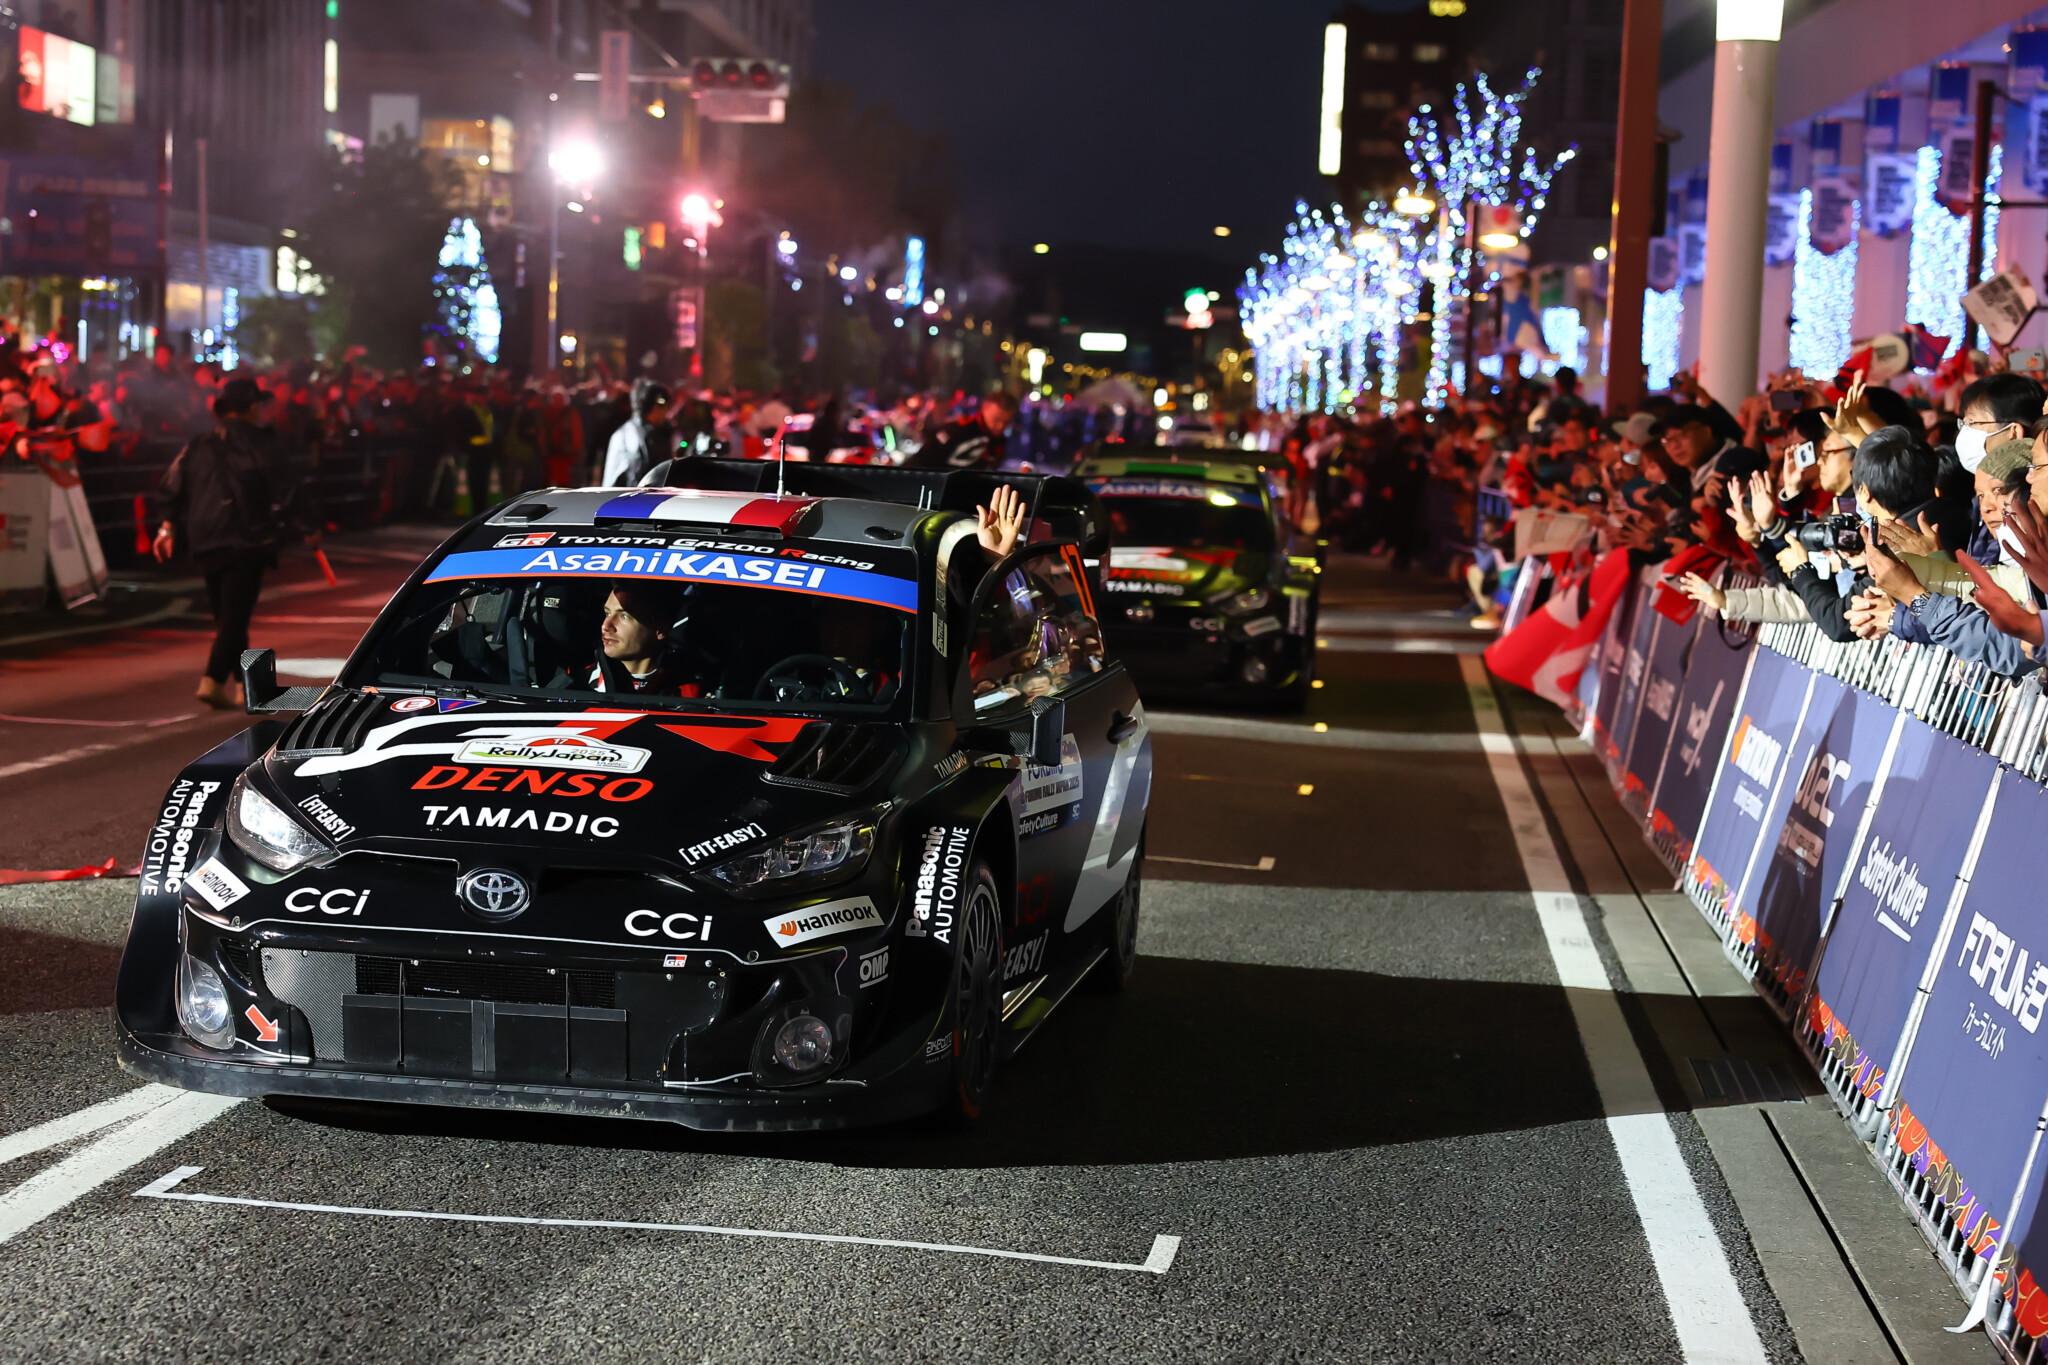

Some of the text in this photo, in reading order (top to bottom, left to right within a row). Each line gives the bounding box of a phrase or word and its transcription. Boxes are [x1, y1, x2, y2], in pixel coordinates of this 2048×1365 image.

[500, 537, 545, 547] GR
[558, 536, 875, 570] TOYOTA GAZOO Racing
[1106, 581, 1184, 595] TAMADIC
[571, 748, 606, 756] 2025
[410, 765, 655, 803] DENSO
[142, 779, 194, 896] AUTOMOTIVE
[164, 781, 221, 894] Panasonic
[422, 805, 620, 839] TAMADIC
[1019, 813, 1058, 834] afetyCulture
[905, 826, 946, 938] Panasonic
[933, 827, 970, 945] AUTOMOTIVE
[284, 887, 371, 916] CCi
[624, 909, 713, 941] CCi
[860, 953, 888, 982] OMP
